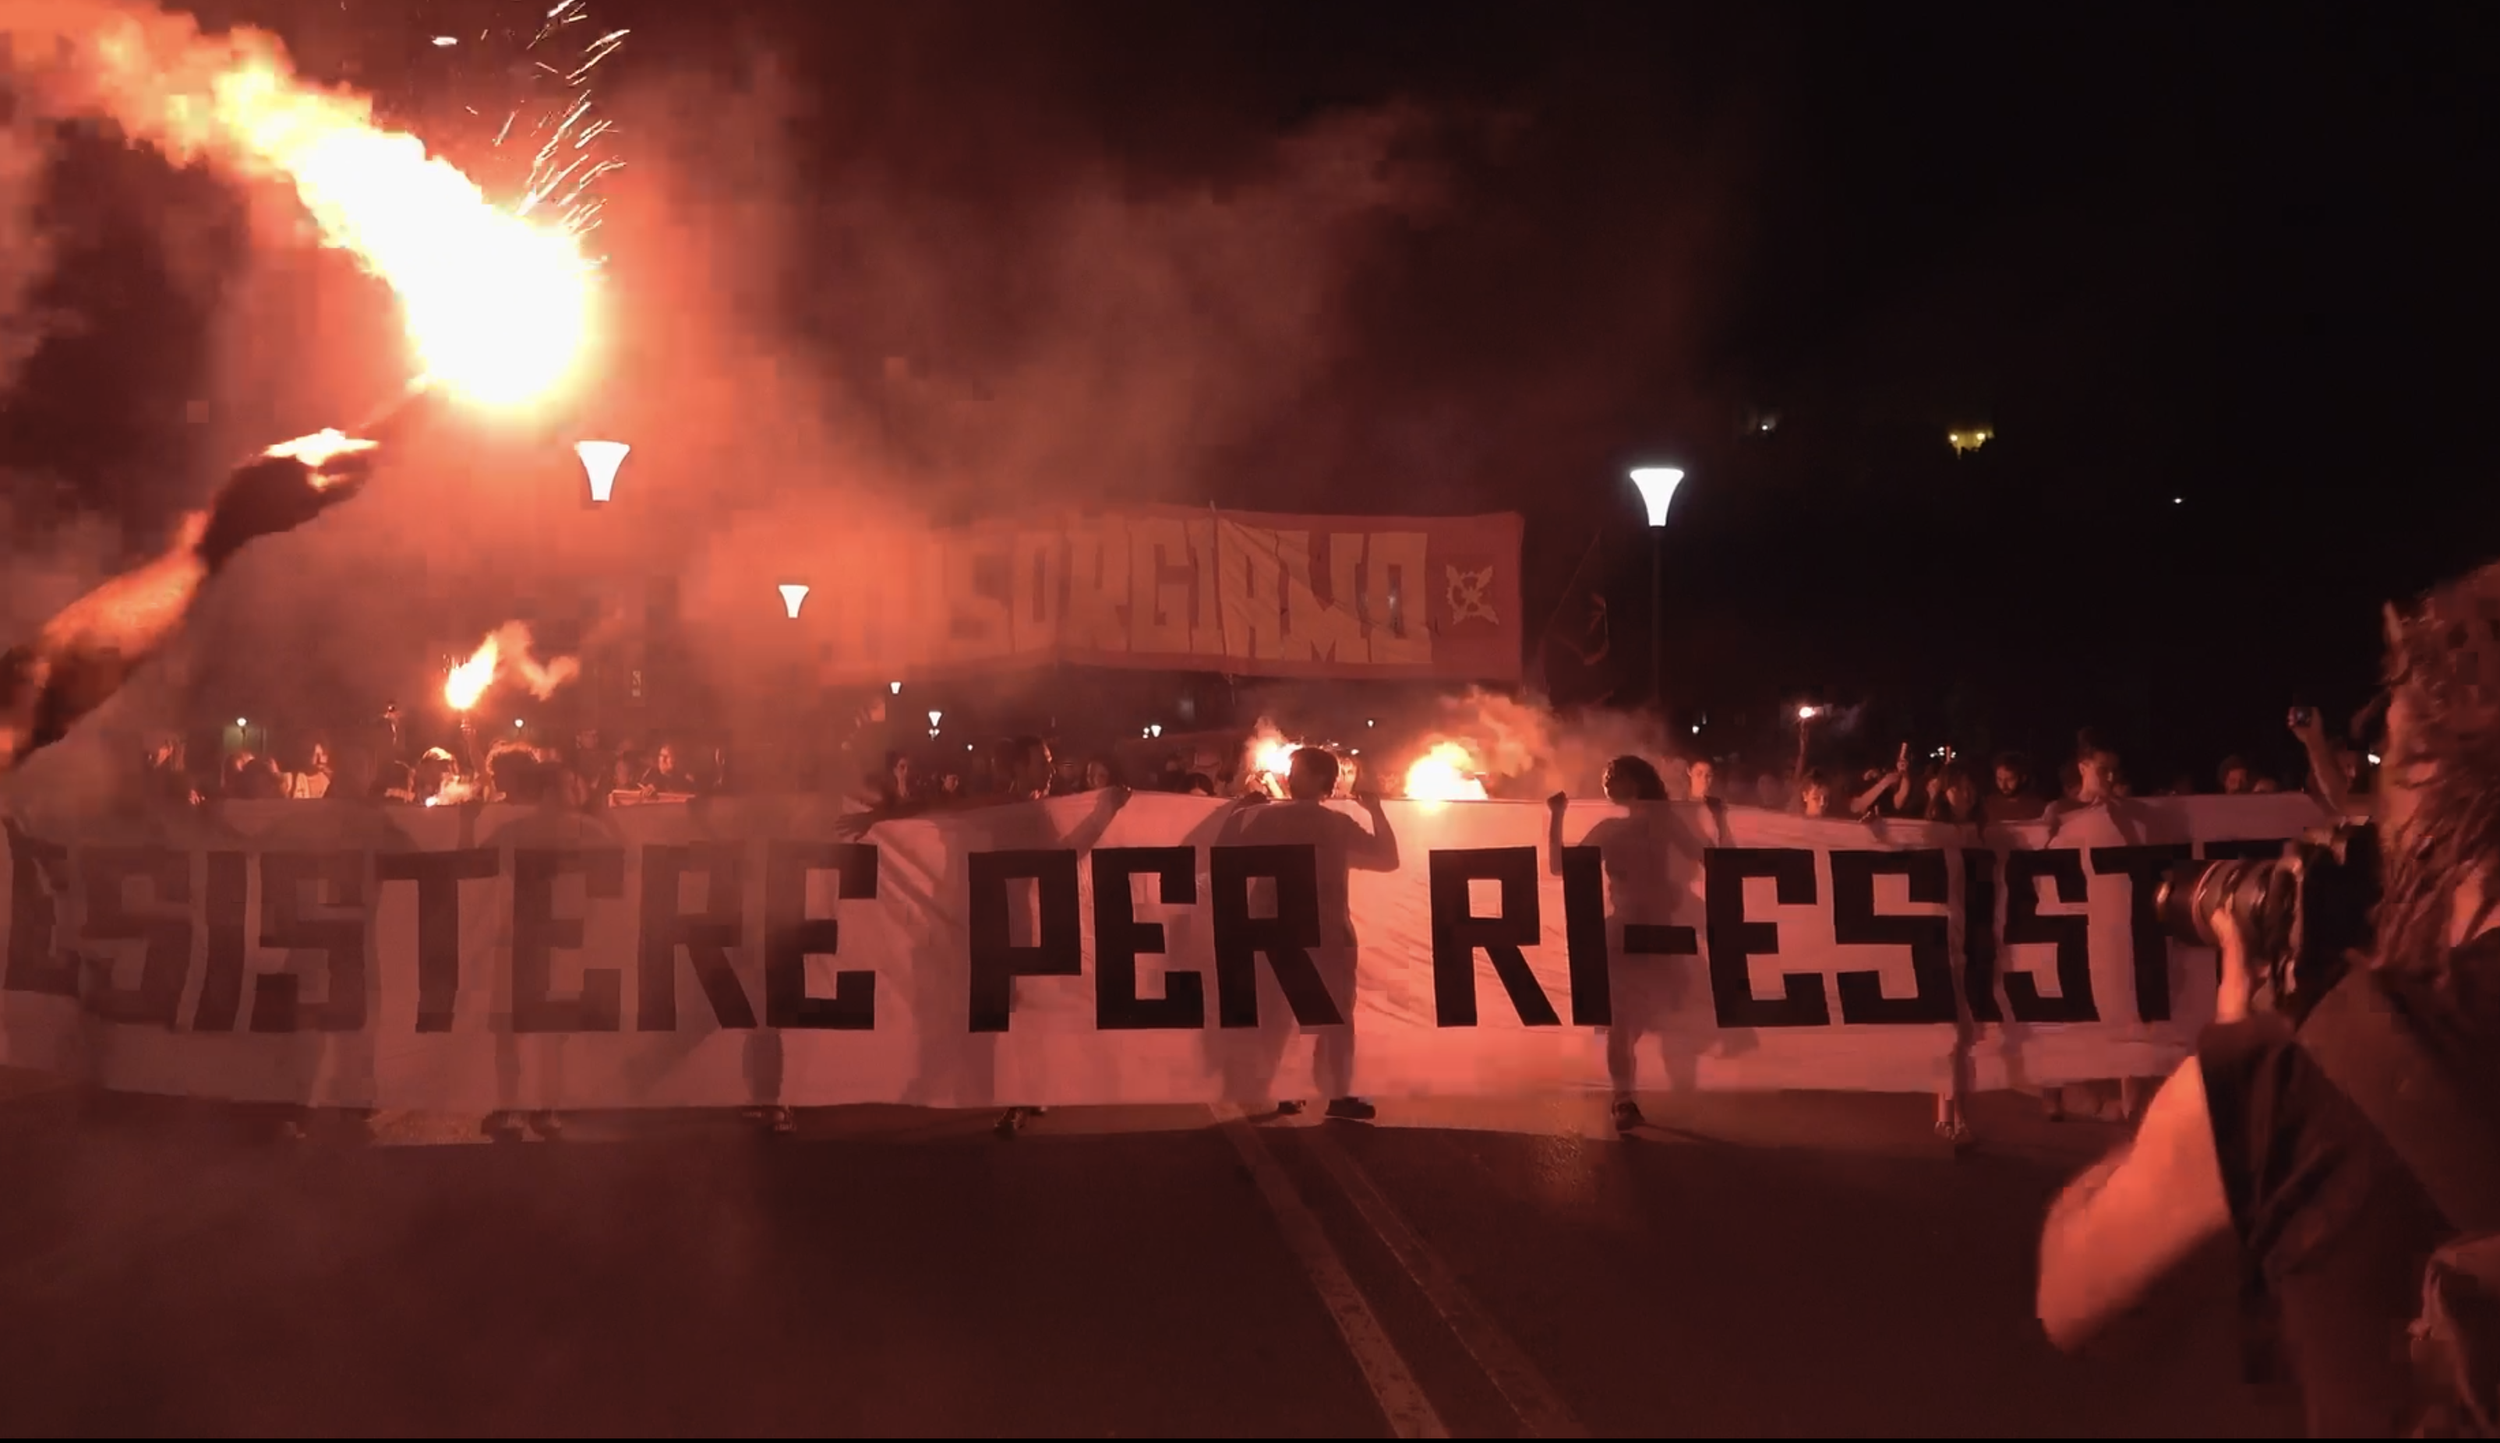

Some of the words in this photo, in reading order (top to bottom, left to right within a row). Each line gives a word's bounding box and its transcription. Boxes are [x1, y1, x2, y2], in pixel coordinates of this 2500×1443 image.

[830, 524, 1429, 663] SORGIAMO
[969, 846, 1343, 1032] PER
[1429, 839, 2290, 1030] RI-ESIST
